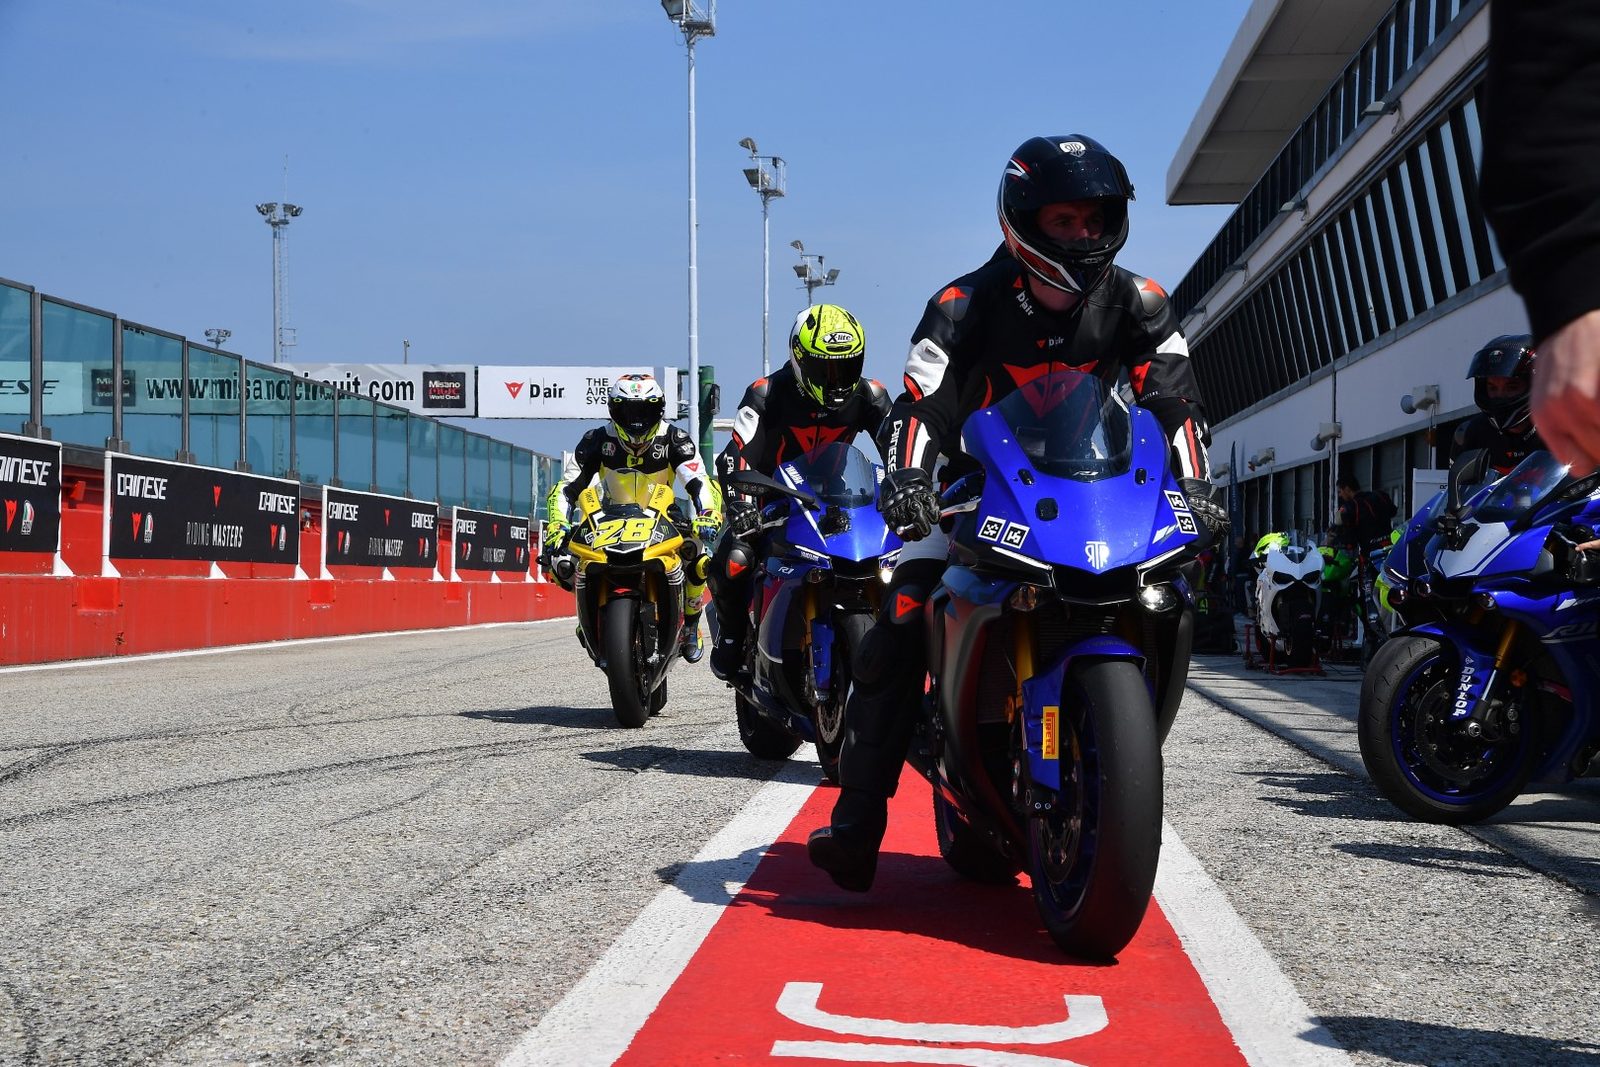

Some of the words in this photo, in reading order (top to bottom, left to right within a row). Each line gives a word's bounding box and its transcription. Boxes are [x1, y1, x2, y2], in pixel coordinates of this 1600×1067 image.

[428, 380, 461, 389] Misano
[586, 377, 609, 387] THE
[117, 472, 168, 500] DAINESE
[258, 491, 296, 515] DAINESE
[328, 501, 359, 522] DAINESE
[186, 521, 210, 546] RIDING
[212, 523, 243, 548] MASTERS
[593, 518, 655, 549] 28
[1452, 666, 1475, 717] DUNLOP
